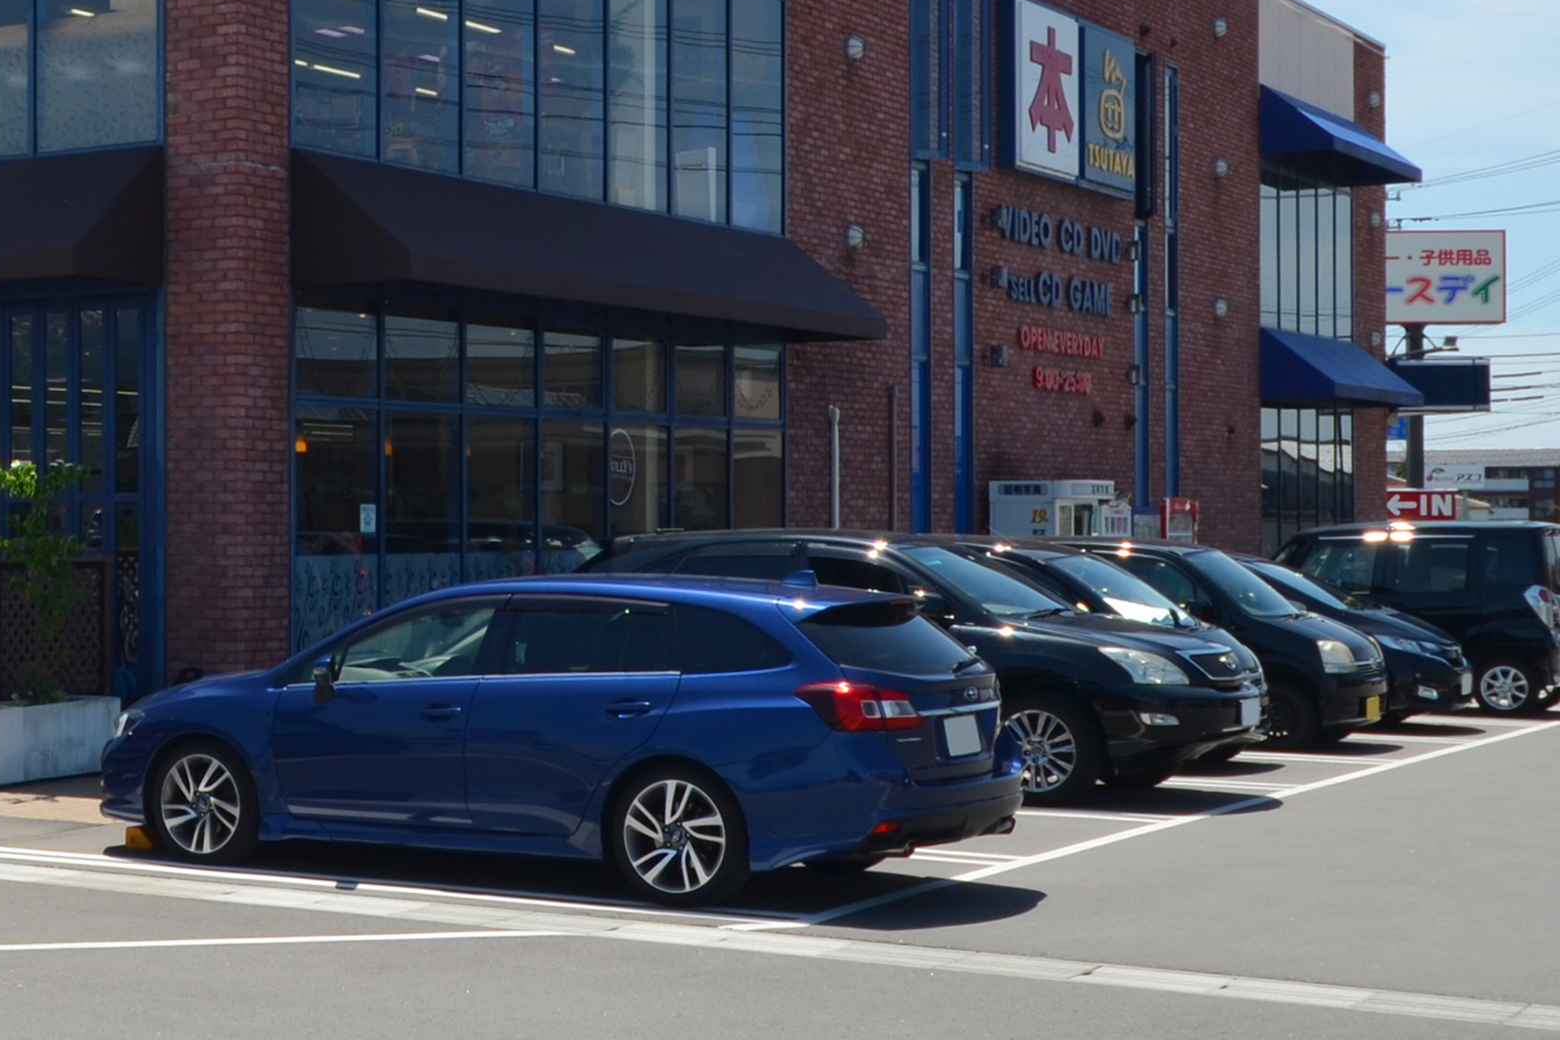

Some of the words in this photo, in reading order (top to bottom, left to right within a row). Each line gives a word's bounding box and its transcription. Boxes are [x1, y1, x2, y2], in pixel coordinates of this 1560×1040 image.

[1028, 26, 1075, 153] 本
[1087, 143, 1136, 178] TSUTAYA
[1003, 206, 1052, 247] VIDEO
[1060, 218, 1084, 255] CD
[1091, 227, 1122, 263] DVD
[1038, 270, 1062, 306] CD
[1070, 277, 1114, 316] GAME
[1020, 324, 1051, 351] OPEN
[1420, 494, 1453, 517] IN
